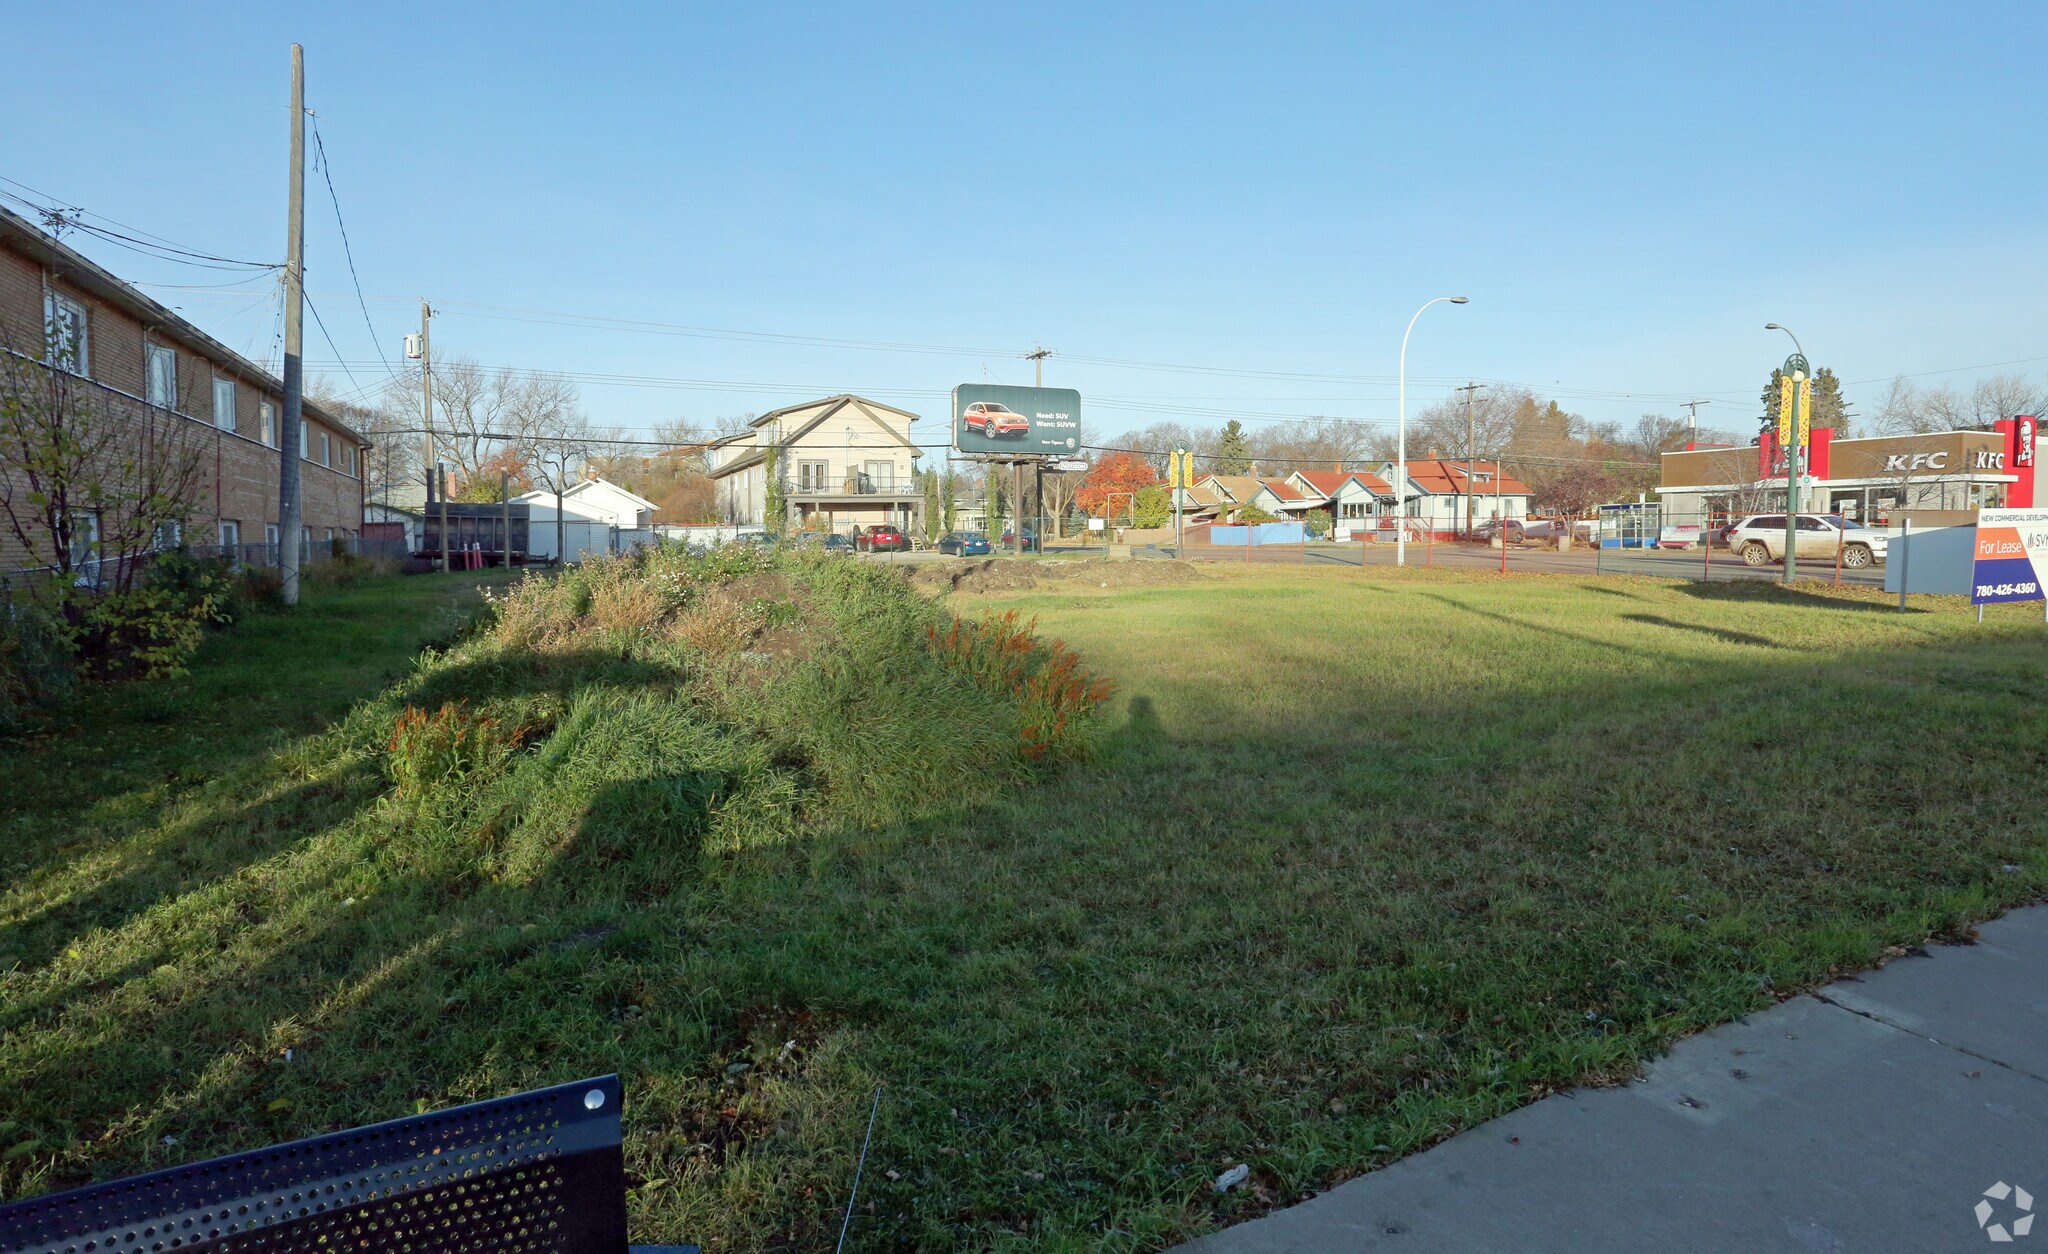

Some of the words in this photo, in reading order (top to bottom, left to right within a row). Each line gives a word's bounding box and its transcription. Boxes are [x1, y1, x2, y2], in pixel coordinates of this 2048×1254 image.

[1884, 452, 1948, 471] KFC
[1976, 451, 2005, 469] KFC
[1980, 541, 1994, 554] For
[1996, 540, 2022, 553] Lease
[1976, 582, 2036, 597] 780-426-4360
